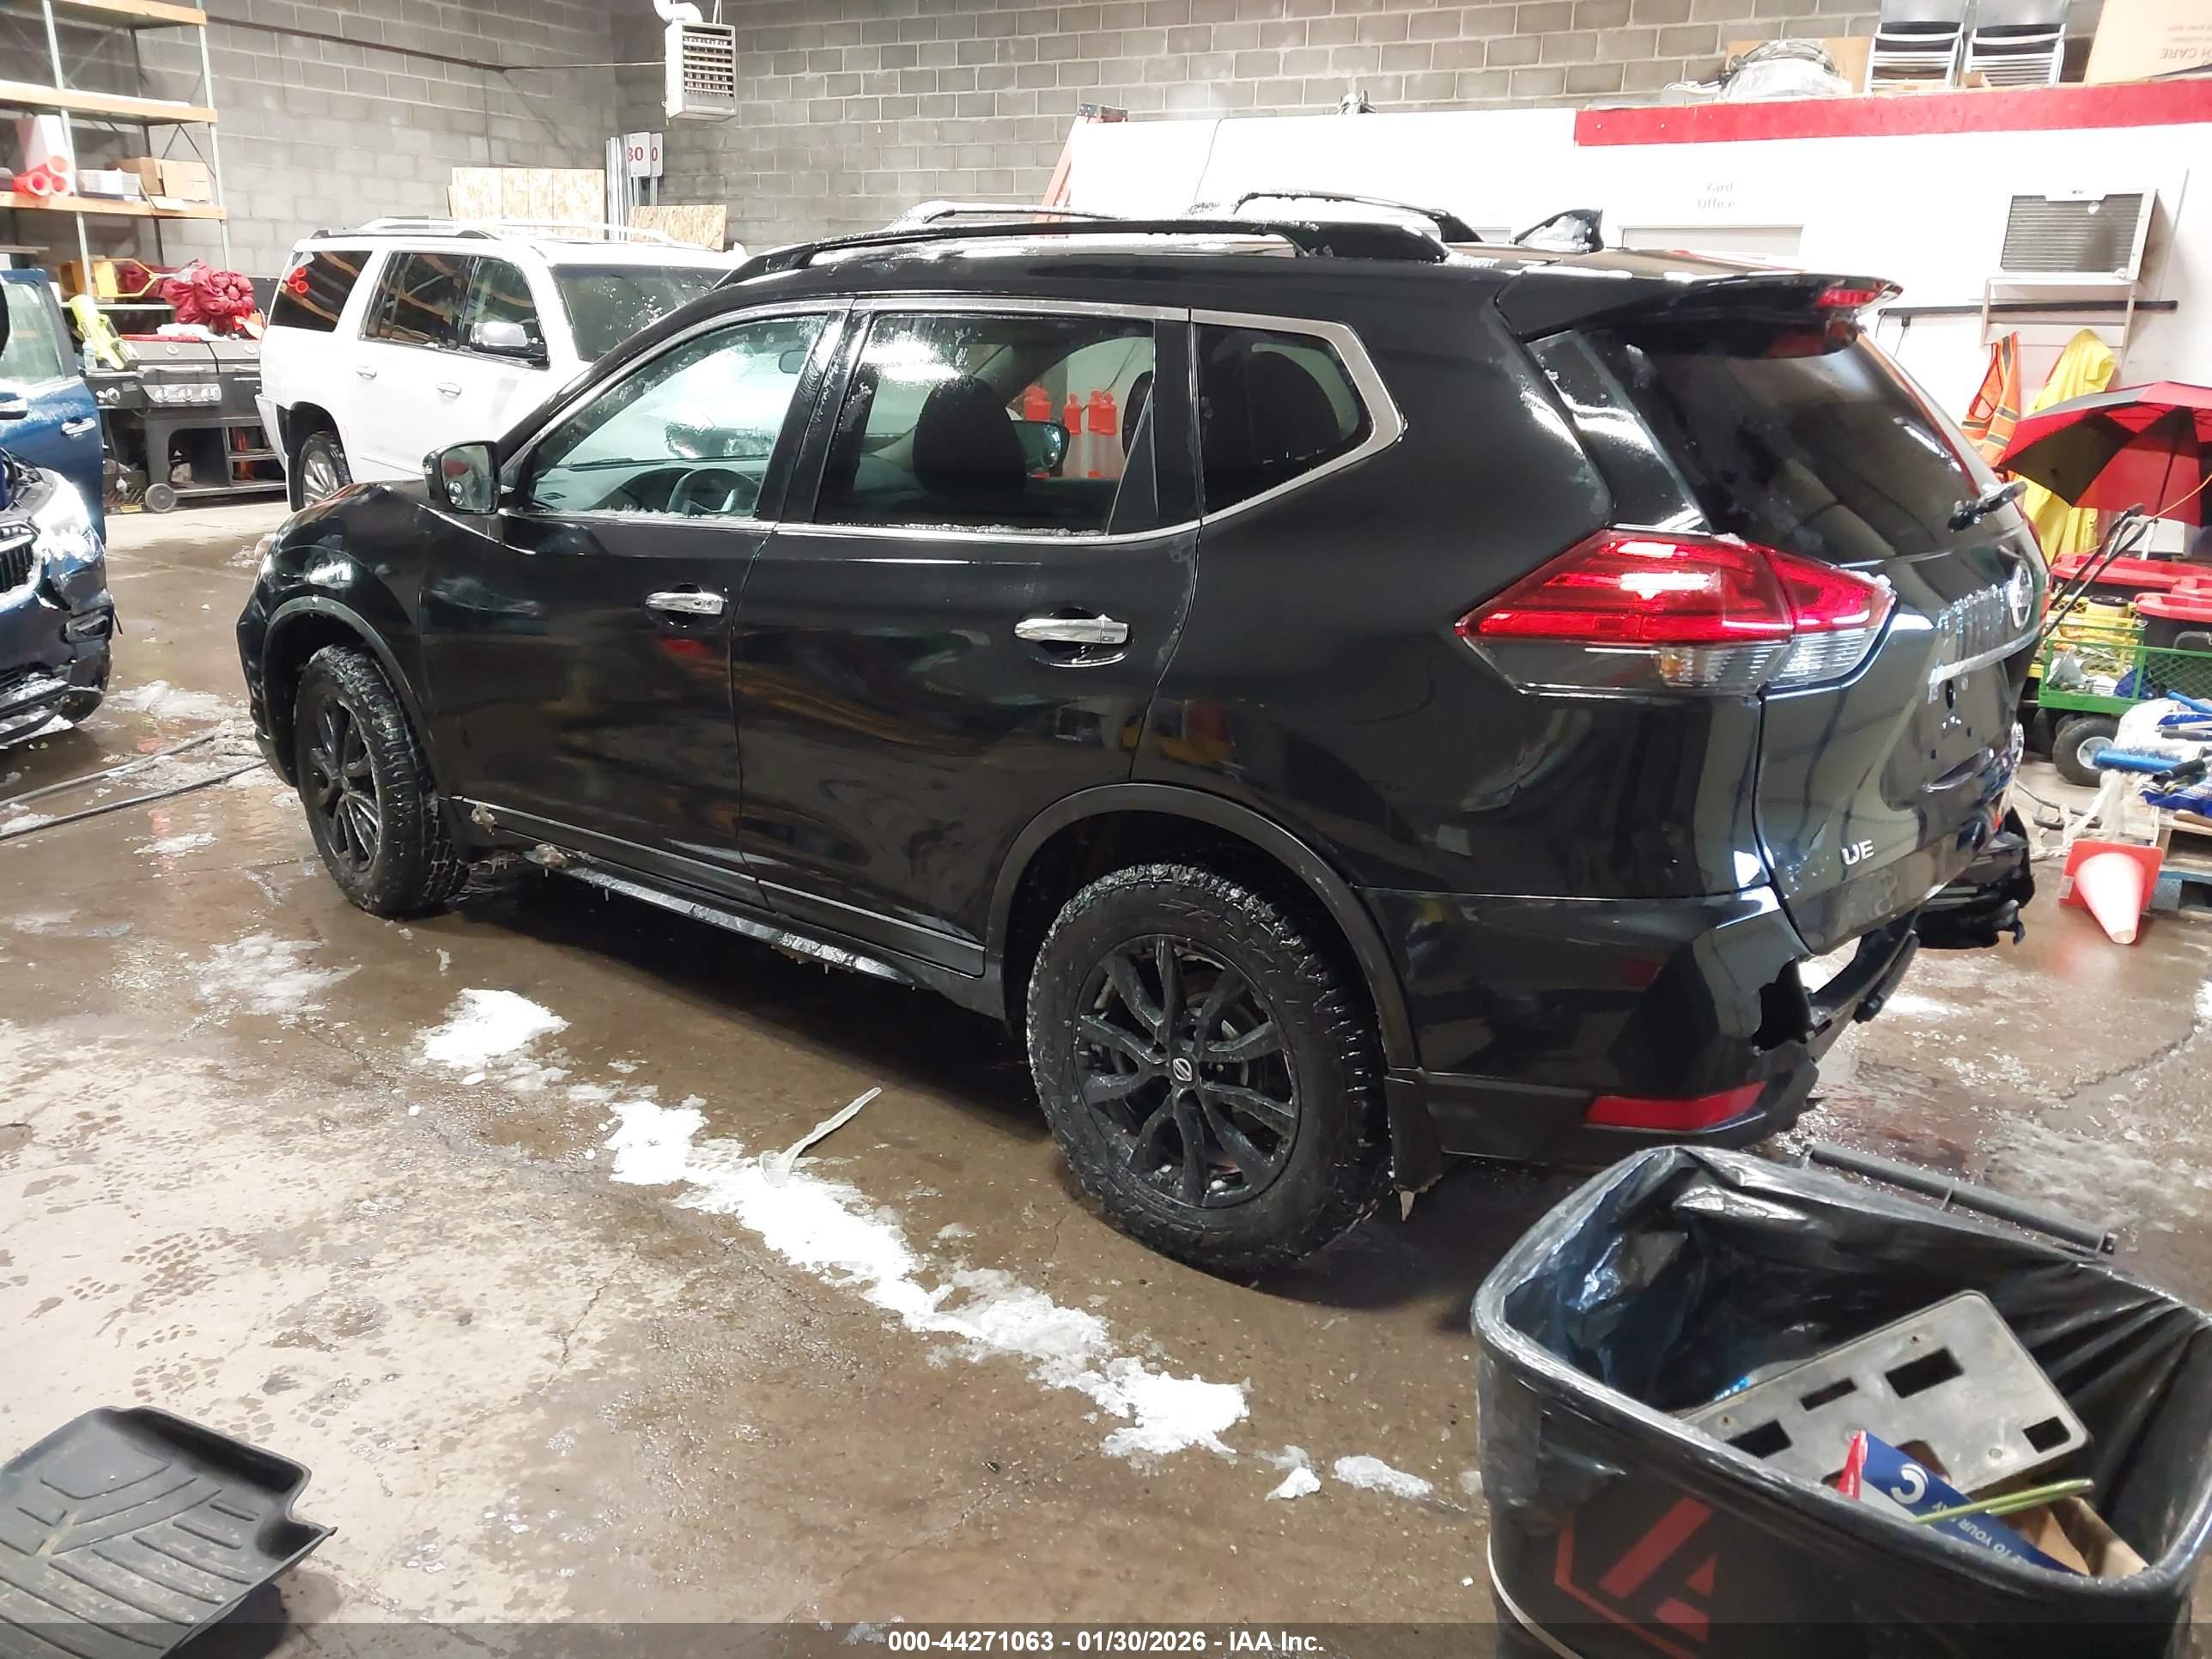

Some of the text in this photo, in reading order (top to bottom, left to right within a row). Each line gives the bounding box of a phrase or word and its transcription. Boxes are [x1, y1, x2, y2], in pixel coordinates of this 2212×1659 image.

[1705, 180, 1734, 192] Yard
[1697, 198, 1735, 210] Office
[1841, 839, 1875, 866] UE
[1958, 1518, 1993, 1546] YOUR
